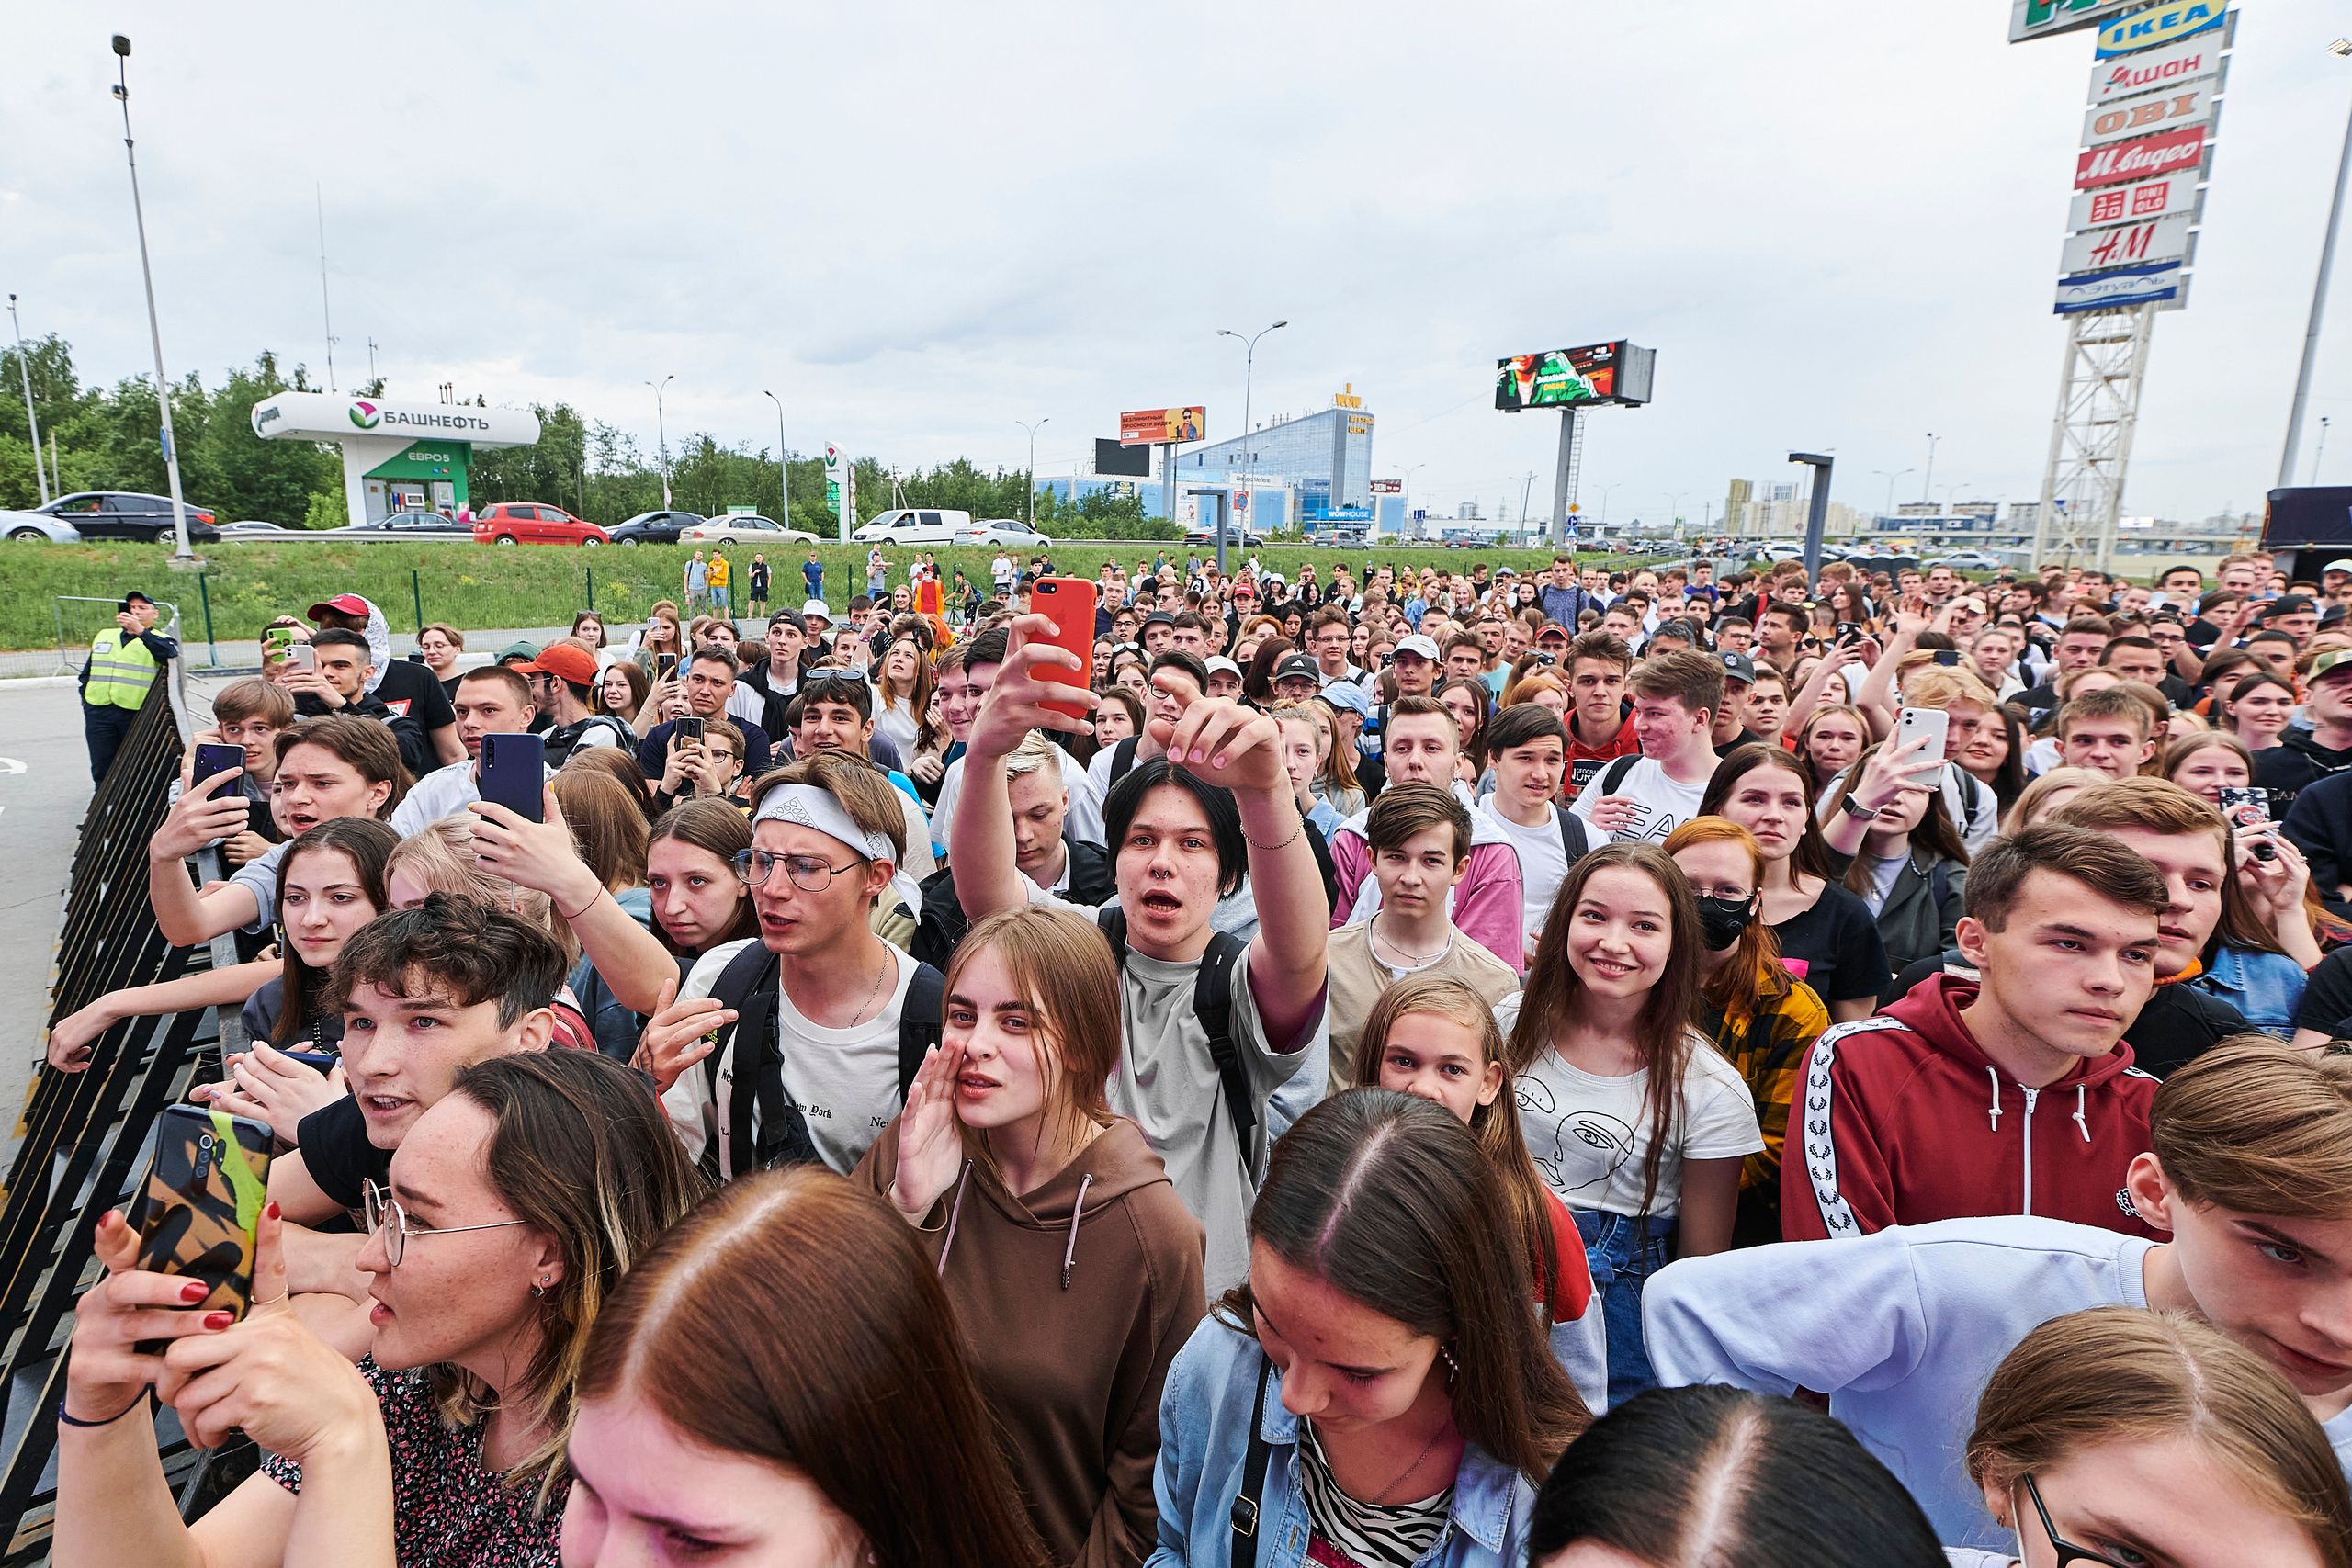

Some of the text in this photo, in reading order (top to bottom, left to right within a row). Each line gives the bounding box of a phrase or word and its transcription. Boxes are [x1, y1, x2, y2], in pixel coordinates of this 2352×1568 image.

[2112, 3, 2211, 44] IKEA
[2094, 91, 2200, 135] OBI
[2086, 222, 2157, 267] H&M
[384, 412, 490, 430] БАШНЕФТЬ
[809, 1104, 831, 1119] York
